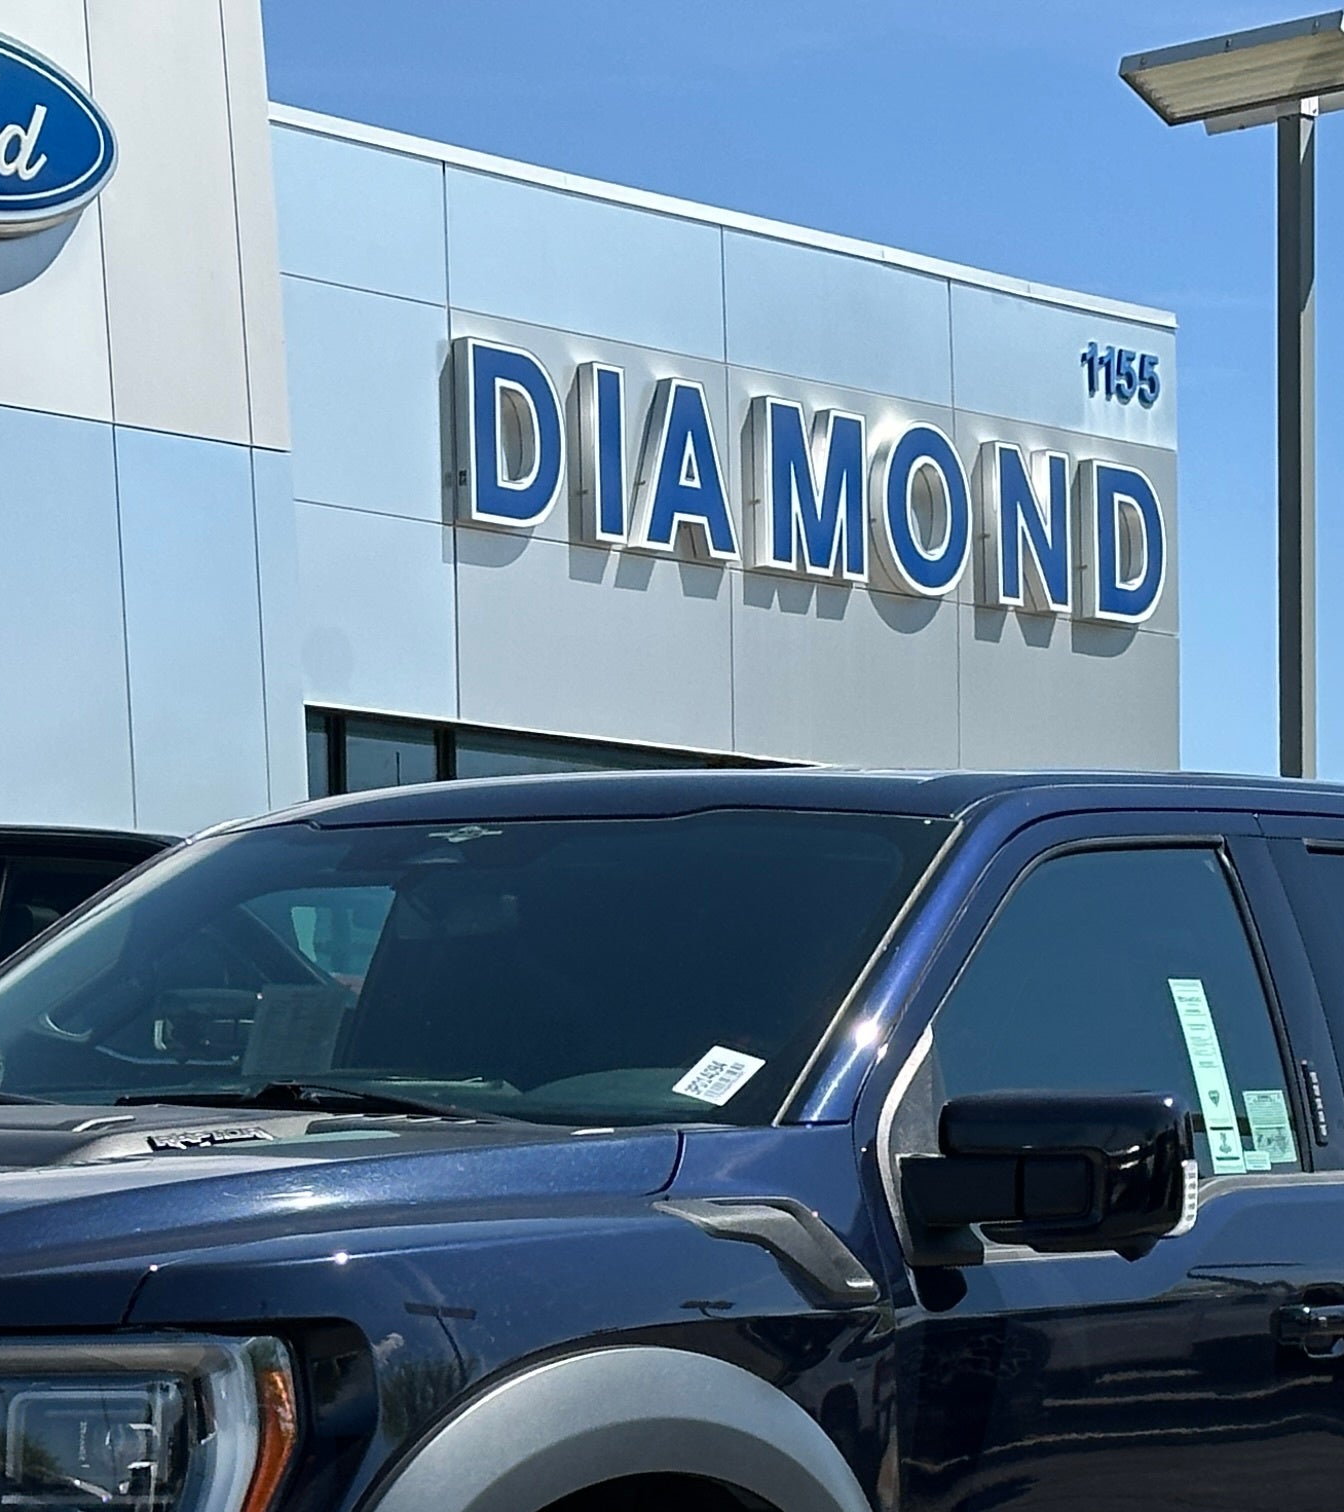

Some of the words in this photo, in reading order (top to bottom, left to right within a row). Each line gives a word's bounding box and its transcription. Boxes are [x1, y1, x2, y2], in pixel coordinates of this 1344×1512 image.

[1080, 341, 1161, 409] 1155
[453, 336, 1167, 624] DIAMOND
[147, 1126, 274, 1150] RAPTOR
